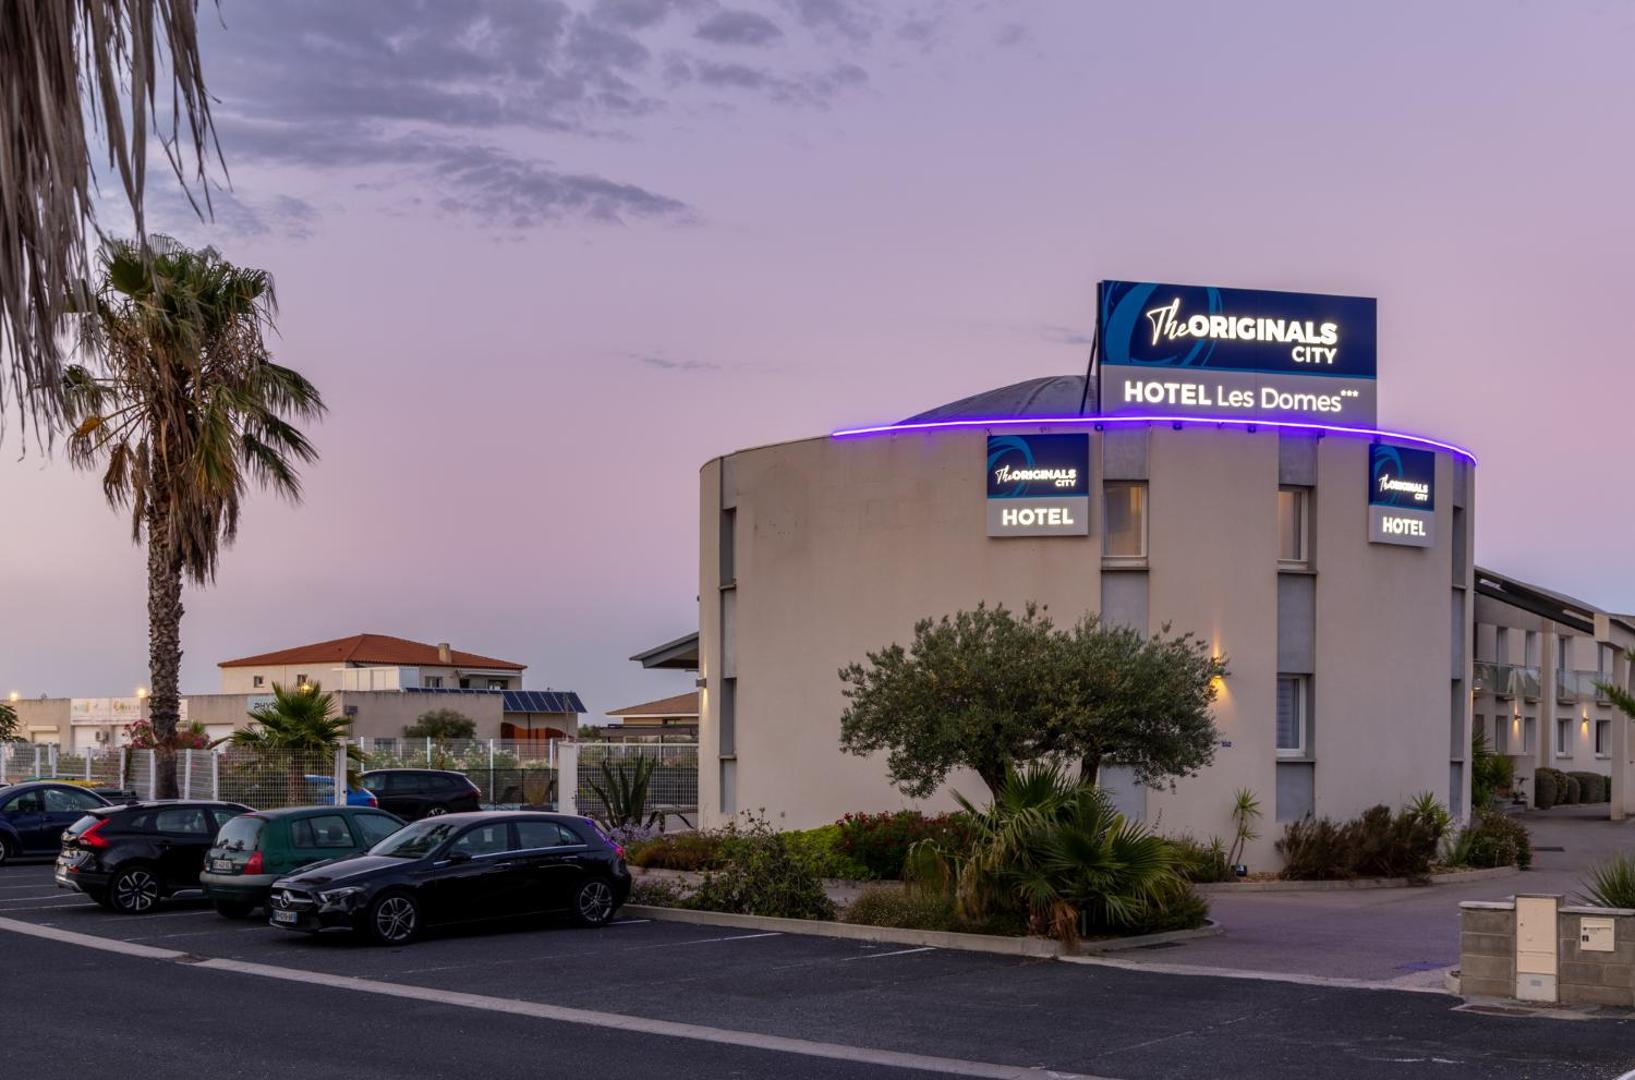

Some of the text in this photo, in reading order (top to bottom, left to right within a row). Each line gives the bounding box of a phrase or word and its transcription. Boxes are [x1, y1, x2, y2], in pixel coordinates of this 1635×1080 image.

[1146, 297, 1338, 346] The ORIGINALS
[1291, 346, 1338, 364] CITY
[1124, 381, 1212, 405] HOTEL
[1217, 385, 1254, 407] Les
[1012, 469, 1077, 481] ORIGINALS
[1414, 493, 1429, 502] CITY
[1002, 508, 1075, 526] HOTEL
[1382, 516, 1427, 536] HOTEL
